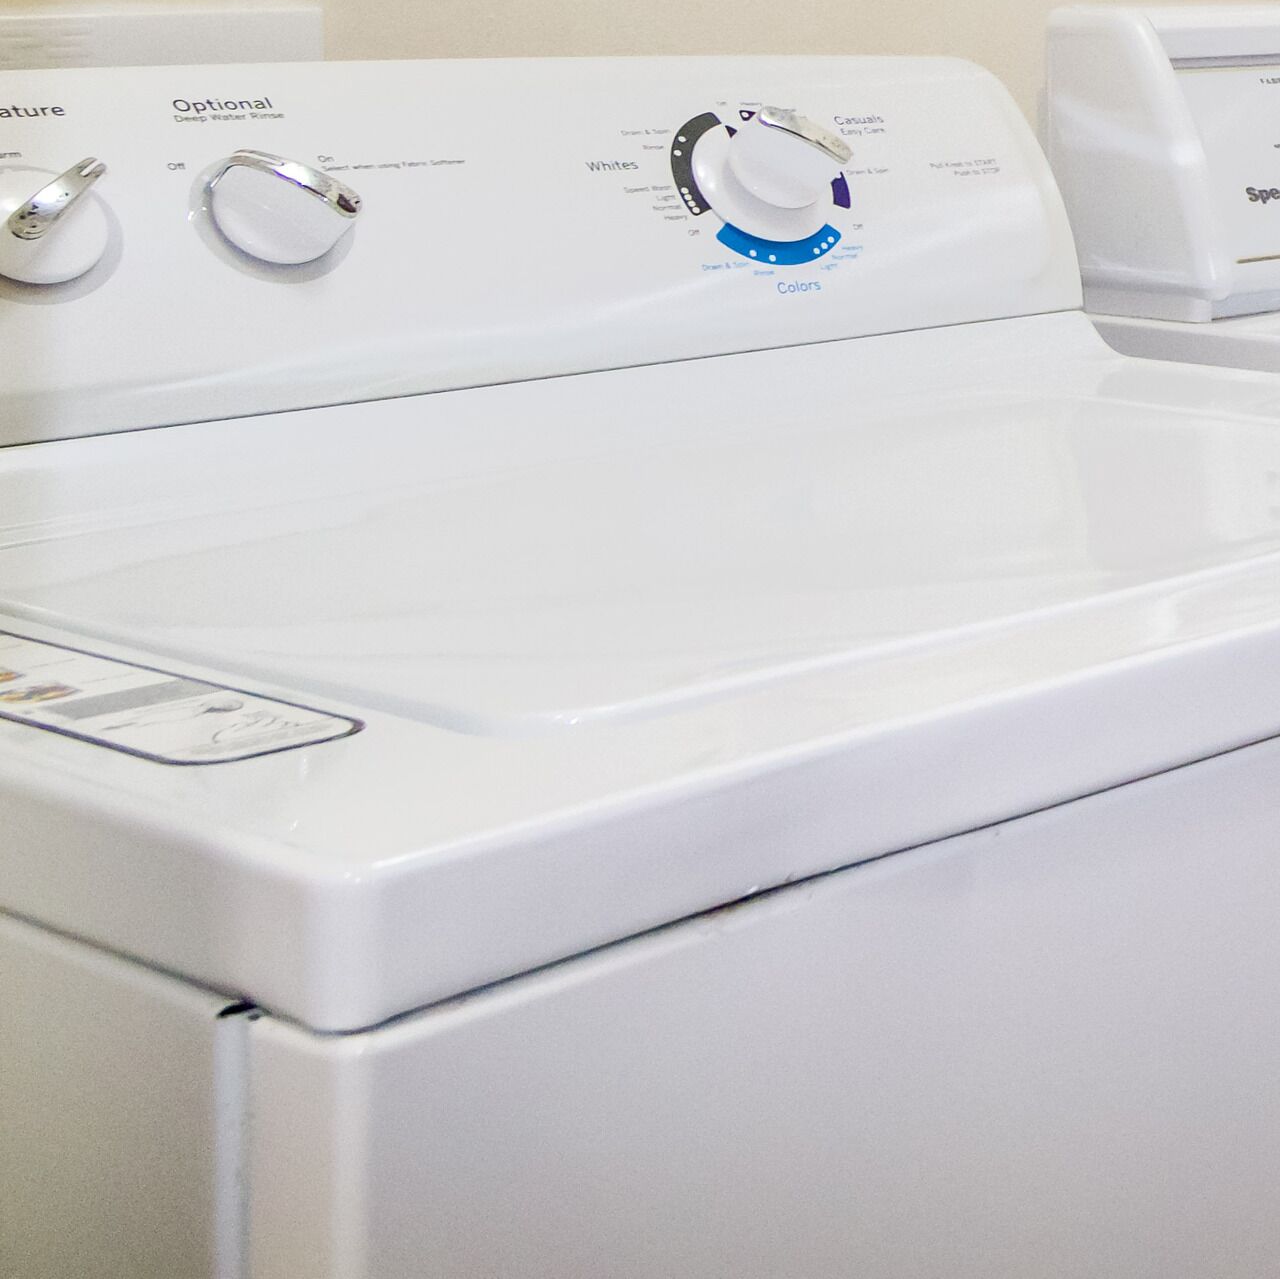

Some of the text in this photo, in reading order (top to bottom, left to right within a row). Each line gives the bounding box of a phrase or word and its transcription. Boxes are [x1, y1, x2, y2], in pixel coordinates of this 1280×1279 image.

[0, 104, 66, 118] ature
[172, 97, 273, 115] Optional
[174, 111, 286, 123] Deep Water Rinse
[834, 115, 885, 125] Casuals
[167, 162, 187, 171] Off
[585, 160, 639, 172] Whites
[777, 280, 822, 295] Colors
